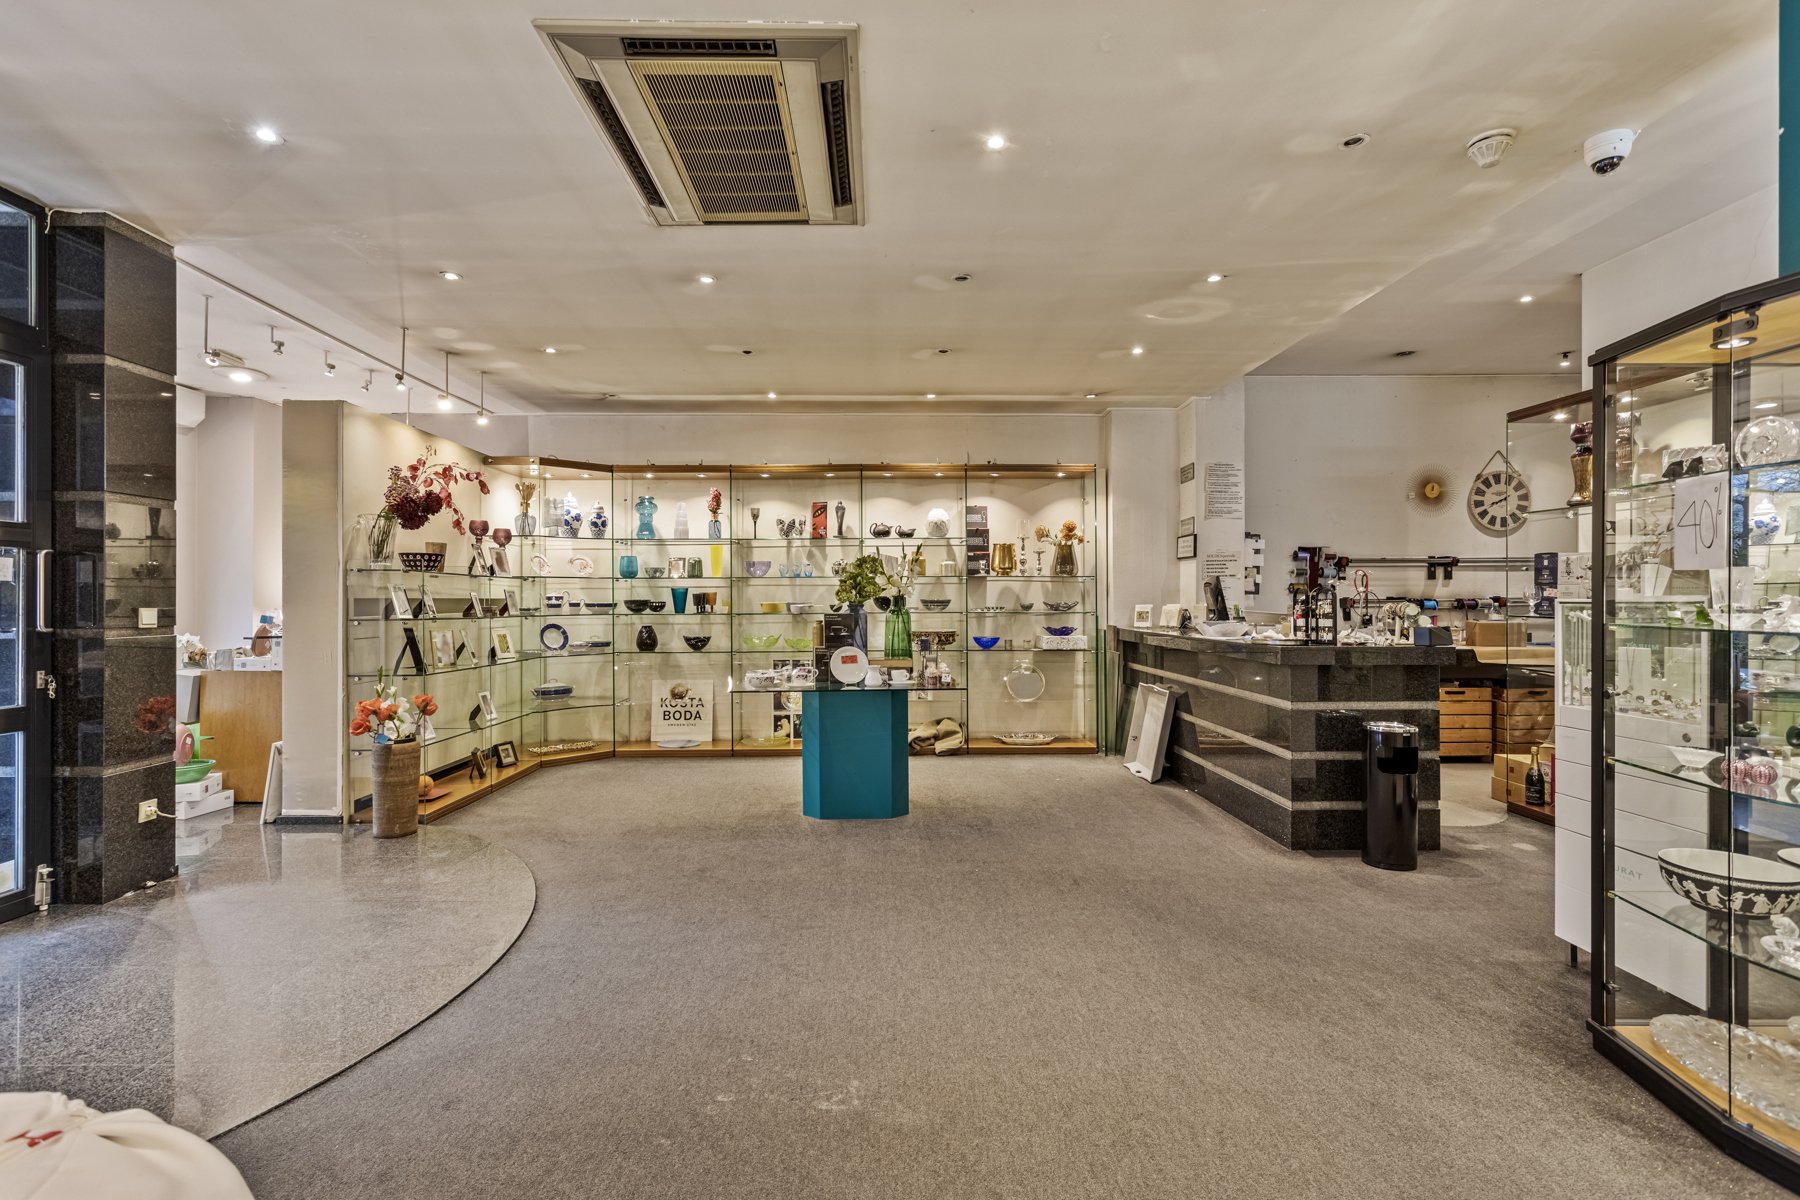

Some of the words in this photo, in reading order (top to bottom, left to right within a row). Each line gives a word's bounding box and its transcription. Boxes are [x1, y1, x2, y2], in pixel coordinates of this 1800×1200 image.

[1677, 481, 1722, 555] 40%
[663, 710, 702, 721] BODA
[1616, 865, 1643, 880] URAT
